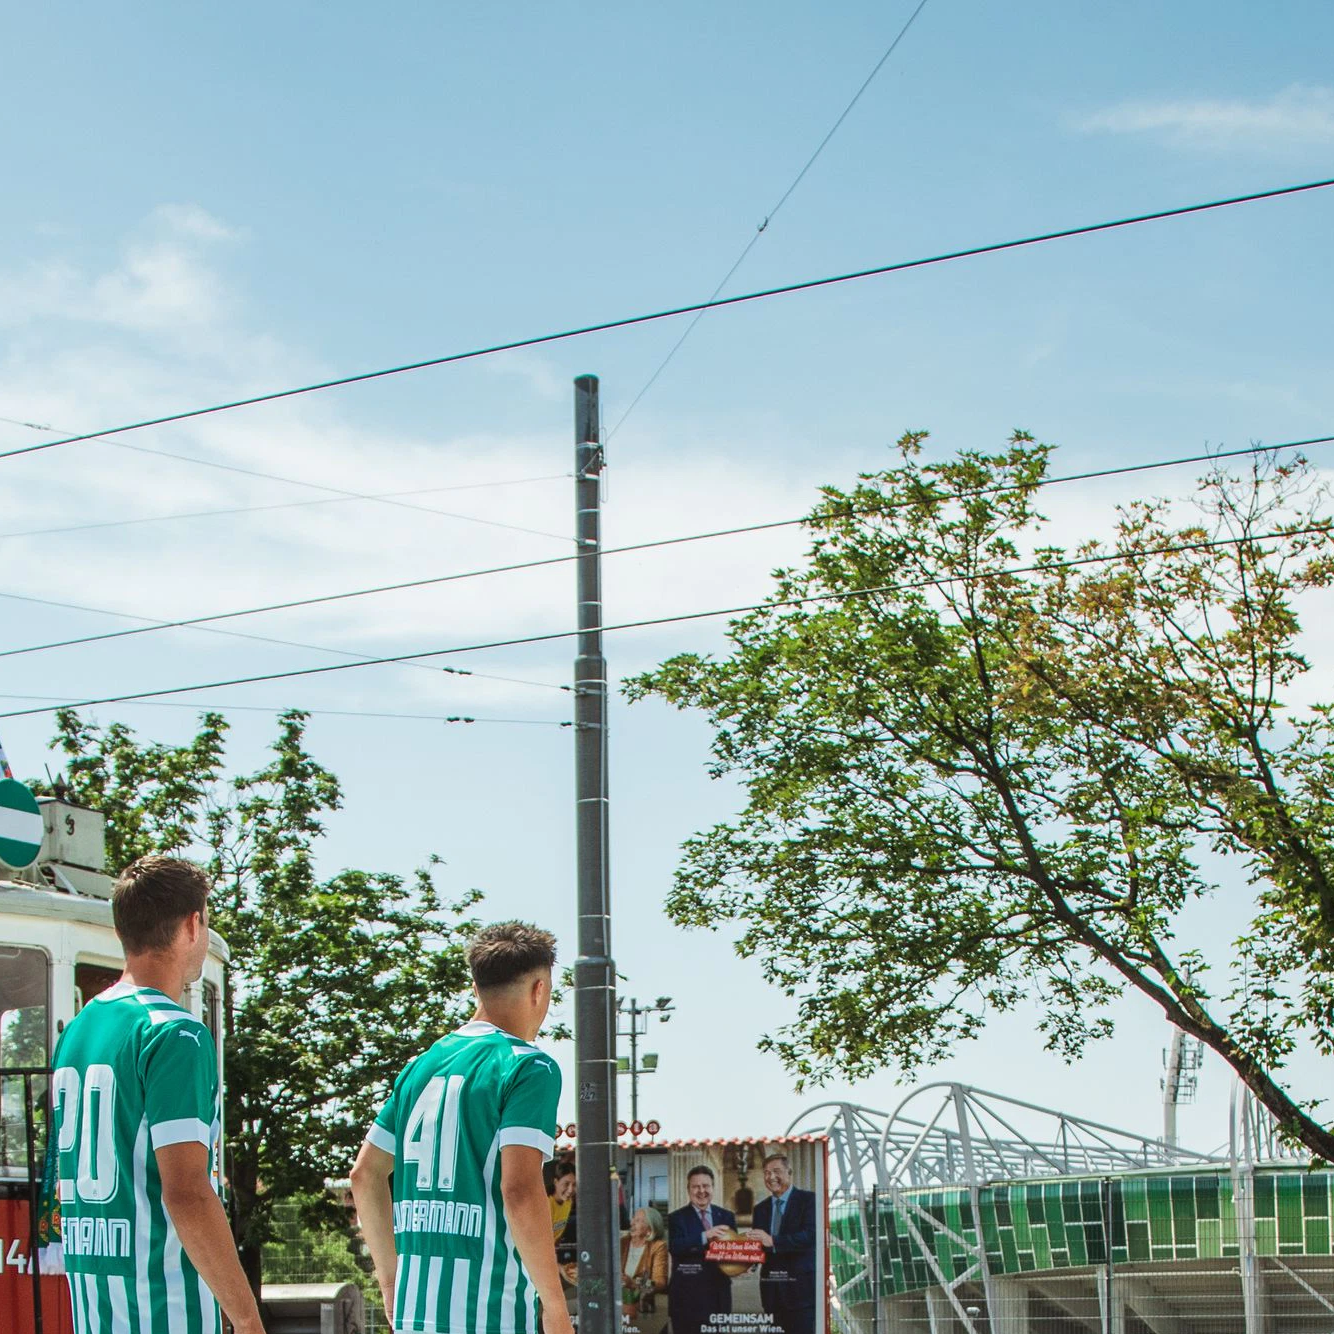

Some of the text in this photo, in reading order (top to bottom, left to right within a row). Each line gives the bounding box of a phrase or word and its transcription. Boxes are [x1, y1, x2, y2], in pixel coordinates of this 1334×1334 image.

[53, 1064, 119, 1205] 20
[403, 1074, 466, 1192] 41
[700, 1324, 785, 1333] Das ist unser Wien.
[709, 1313, 774, 1324] GEMEINSAM
